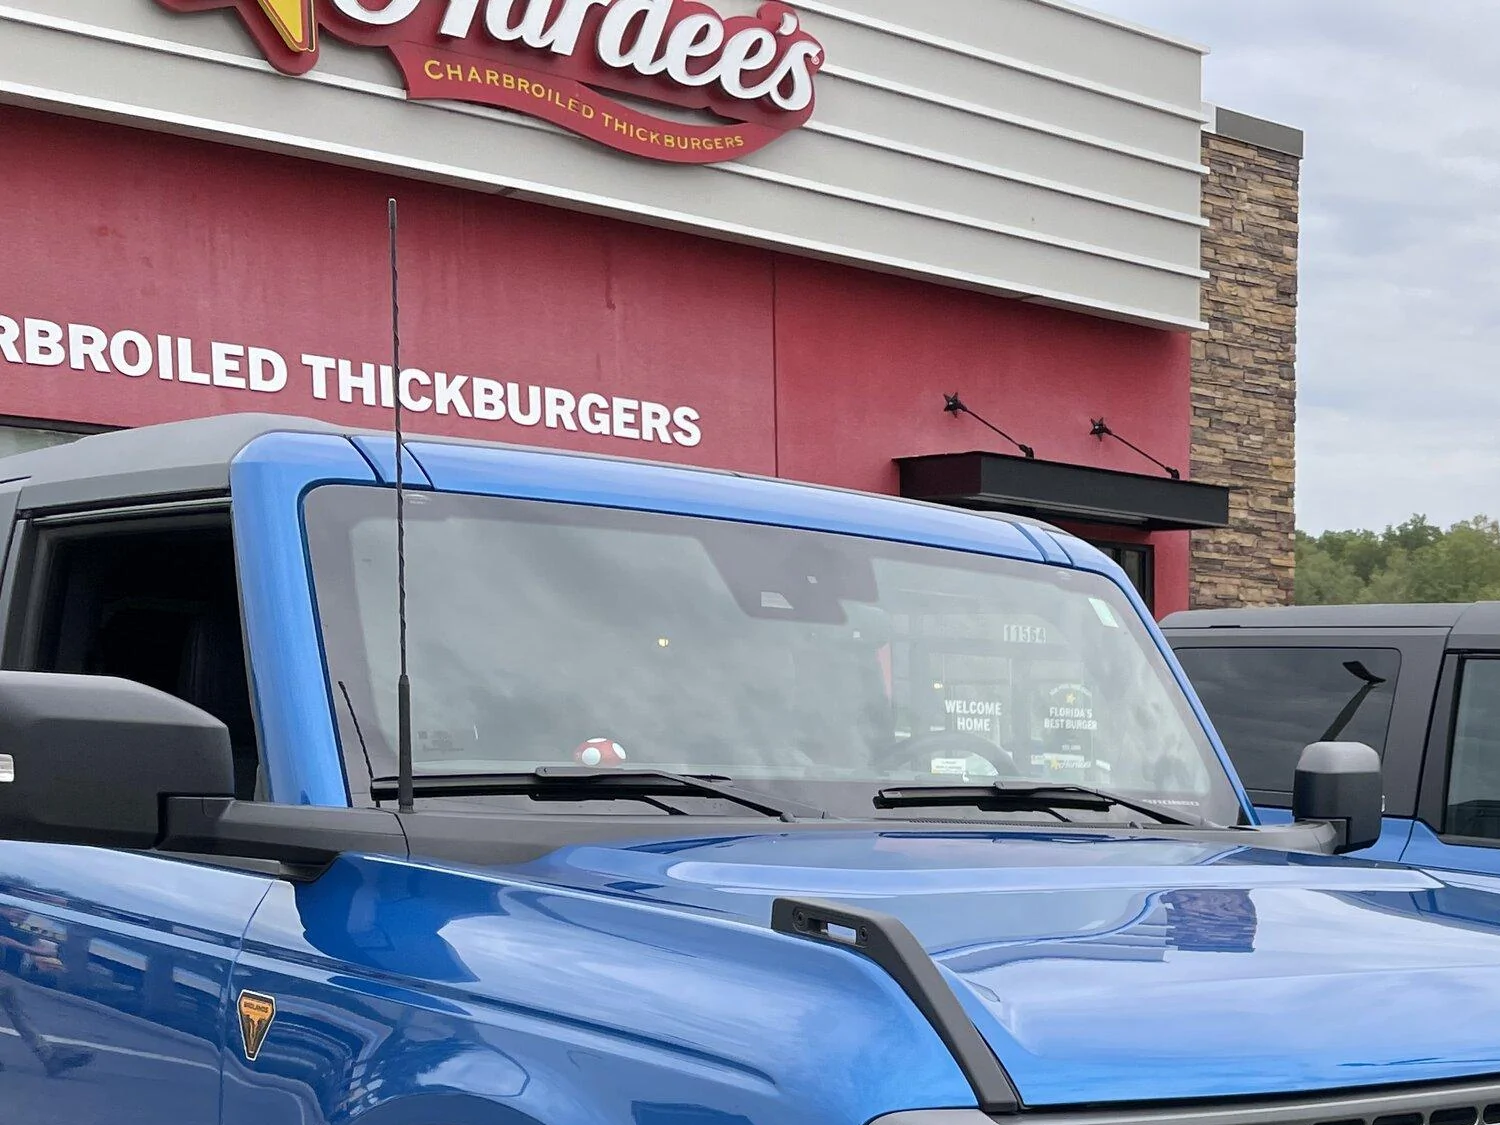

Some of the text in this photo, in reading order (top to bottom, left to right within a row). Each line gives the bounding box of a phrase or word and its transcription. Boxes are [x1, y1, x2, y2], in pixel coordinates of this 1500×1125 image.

[424, 60, 744, 150] CHARBROILED THICKBURGERS
[301, 353, 702, 447] THICKBURGERS
[1004, 624, 1046, 643] 11564
[945, 700, 1002, 715] WELCOME
[1049, 707, 1093, 718] FLORIDA'S
[957, 717, 990, 731] HOME
[1044, 718, 1097, 730] BEST BURGER
